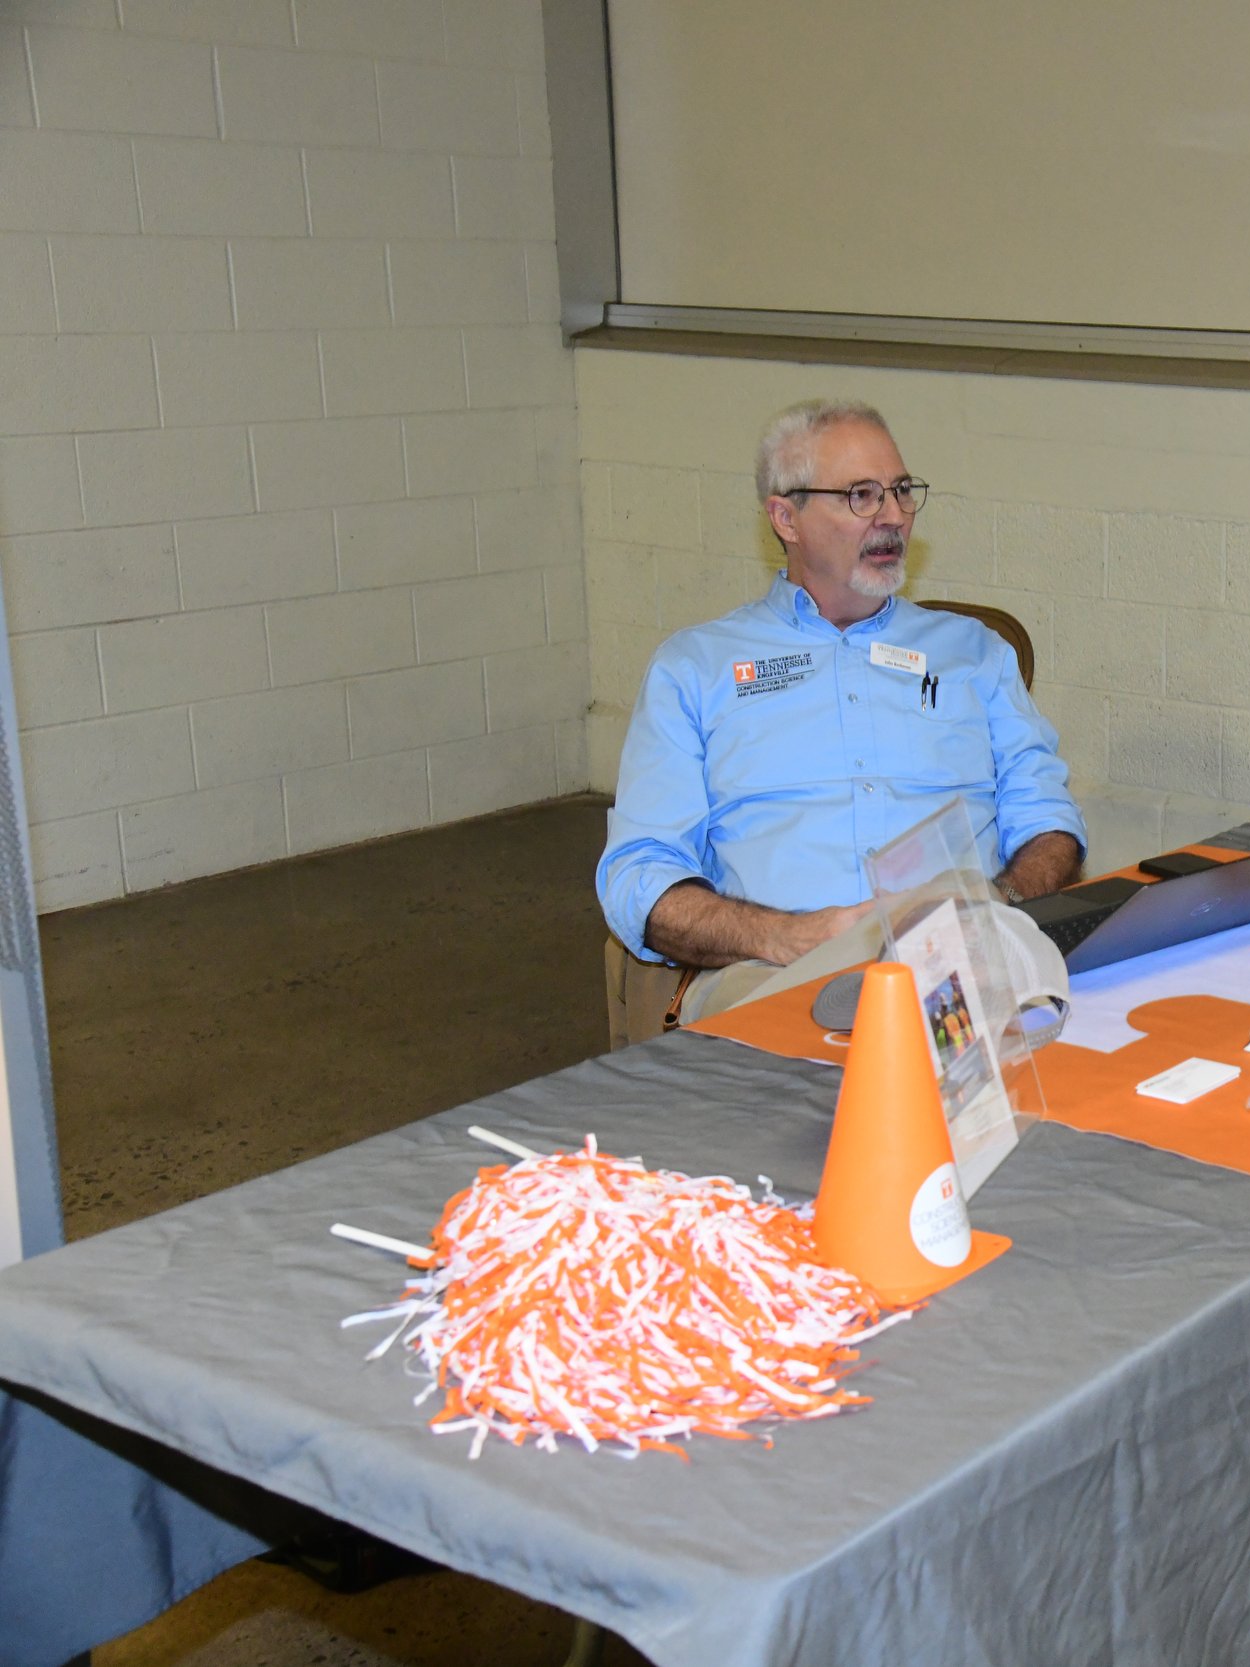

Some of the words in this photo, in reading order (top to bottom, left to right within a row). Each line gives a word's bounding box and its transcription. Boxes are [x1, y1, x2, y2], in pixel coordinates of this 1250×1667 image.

[755, 657, 813, 674] TENNESSEE
[757, 668, 789, 680] KNOXVILLE
[736, 679, 780, 693] CONSTRUCTION
[781, 673, 804, 684] SCIENCE
[737, 690, 749, 698] AND
[749, 684, 789, 696] MANAGEMENT
